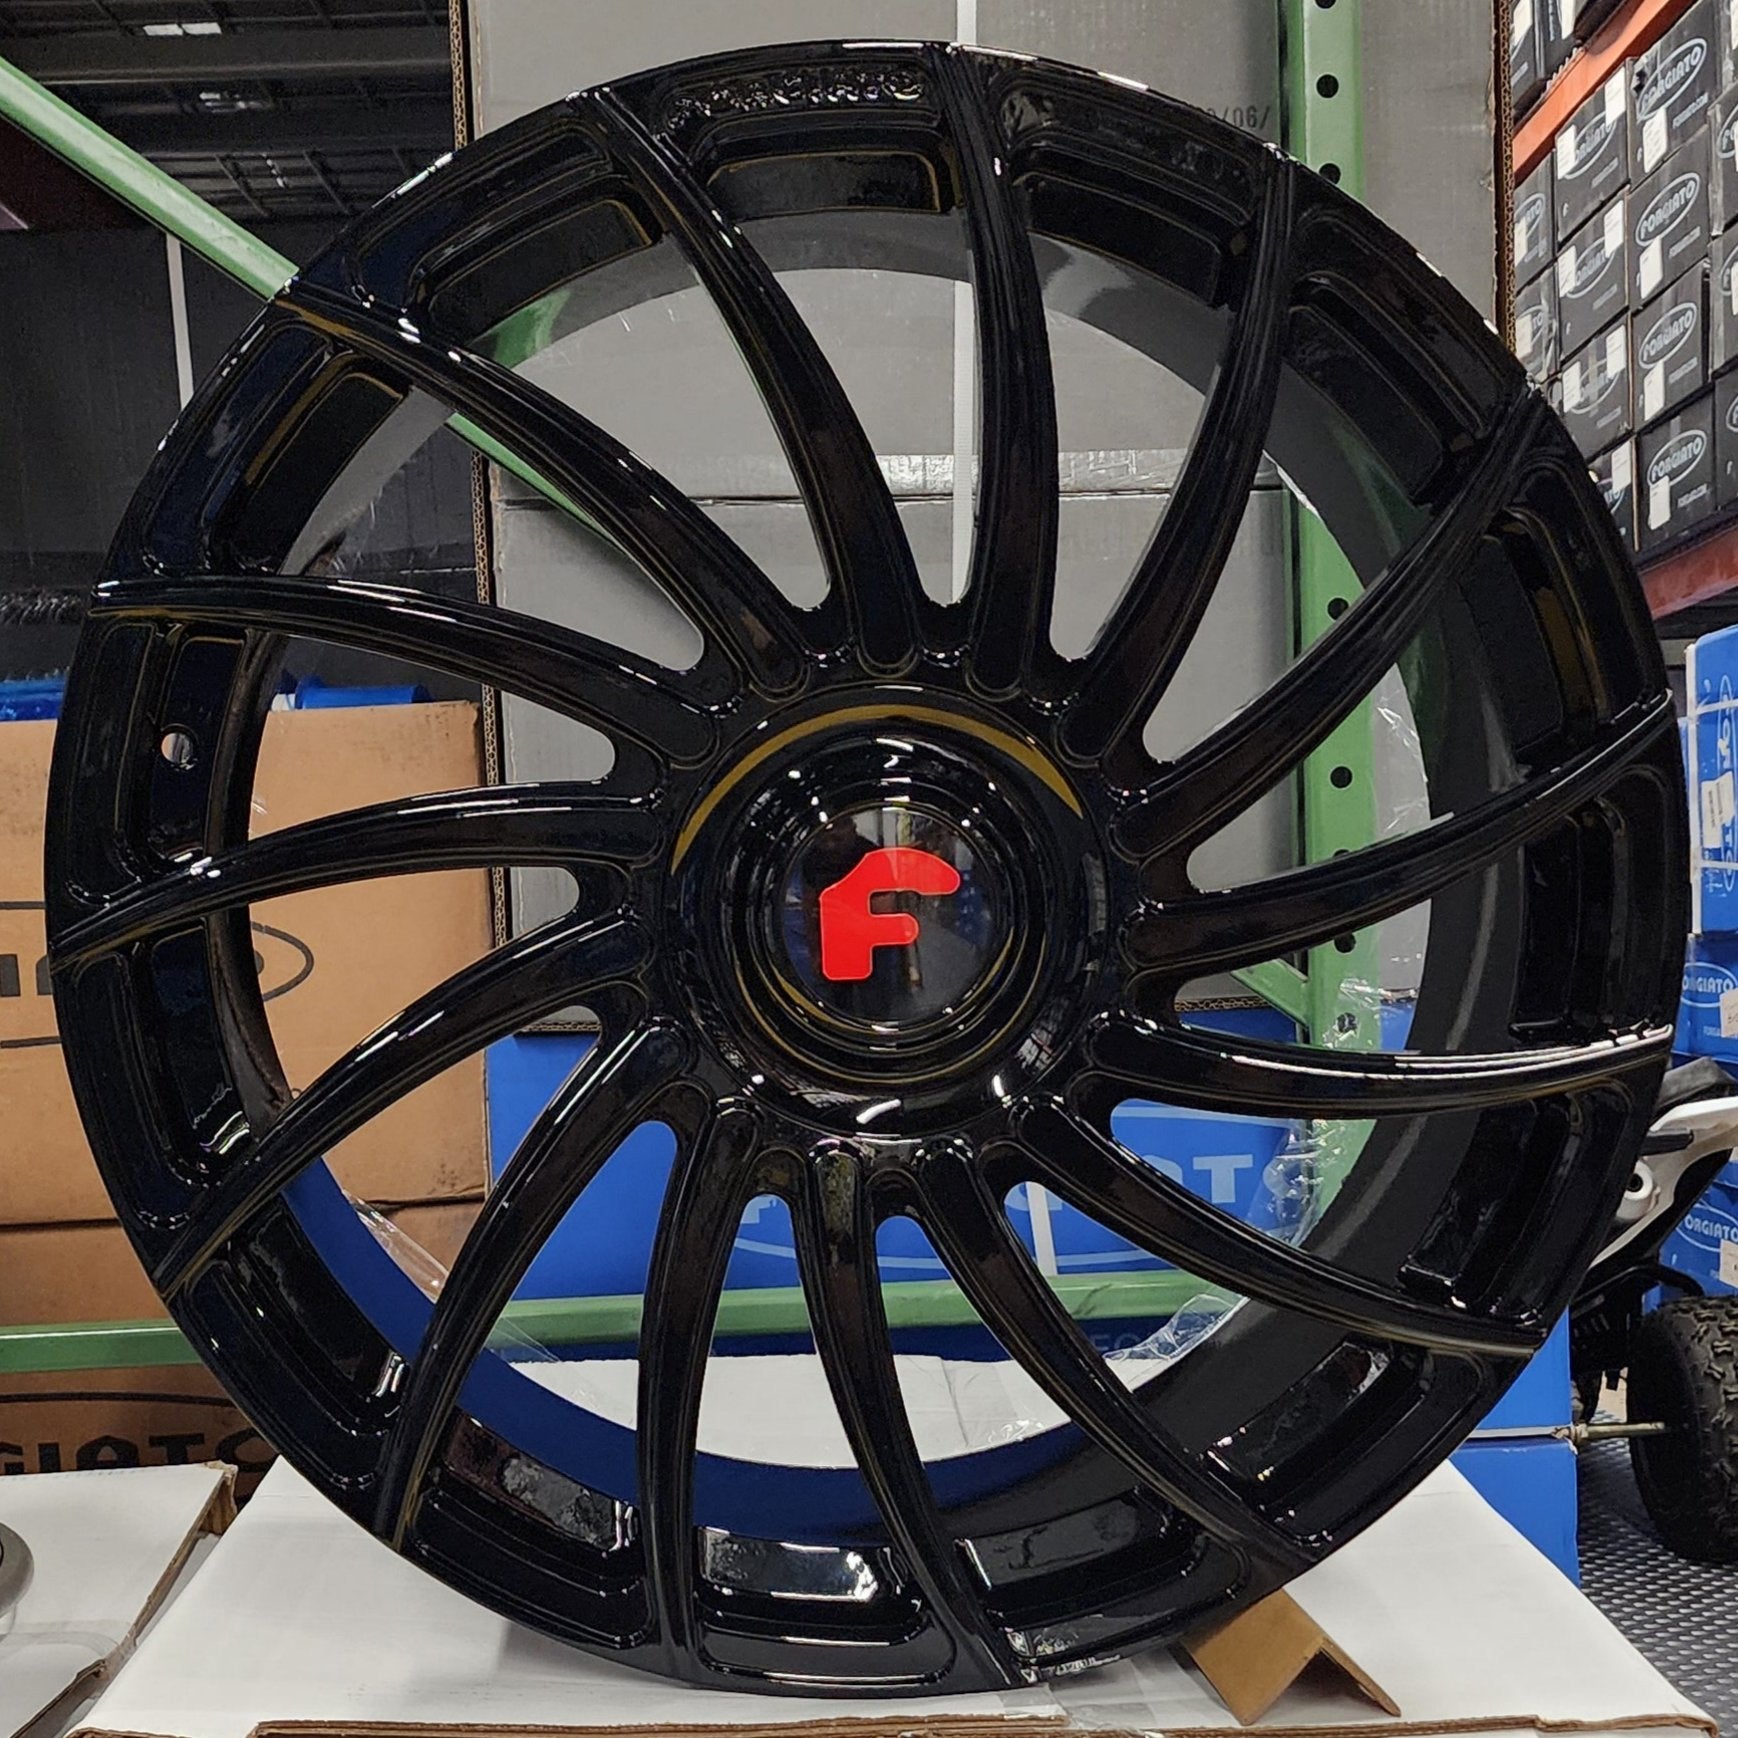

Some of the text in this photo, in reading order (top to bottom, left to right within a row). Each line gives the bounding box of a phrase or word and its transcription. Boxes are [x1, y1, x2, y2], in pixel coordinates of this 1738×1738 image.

[1641, 180, 1696, 240] FORGIATO
[1643, 310, 1693, 361] FORGIATO
[1651, 436, 1703, 482] FORGIATO
[1685, 1213, 1738, 1243] ORGIATO
